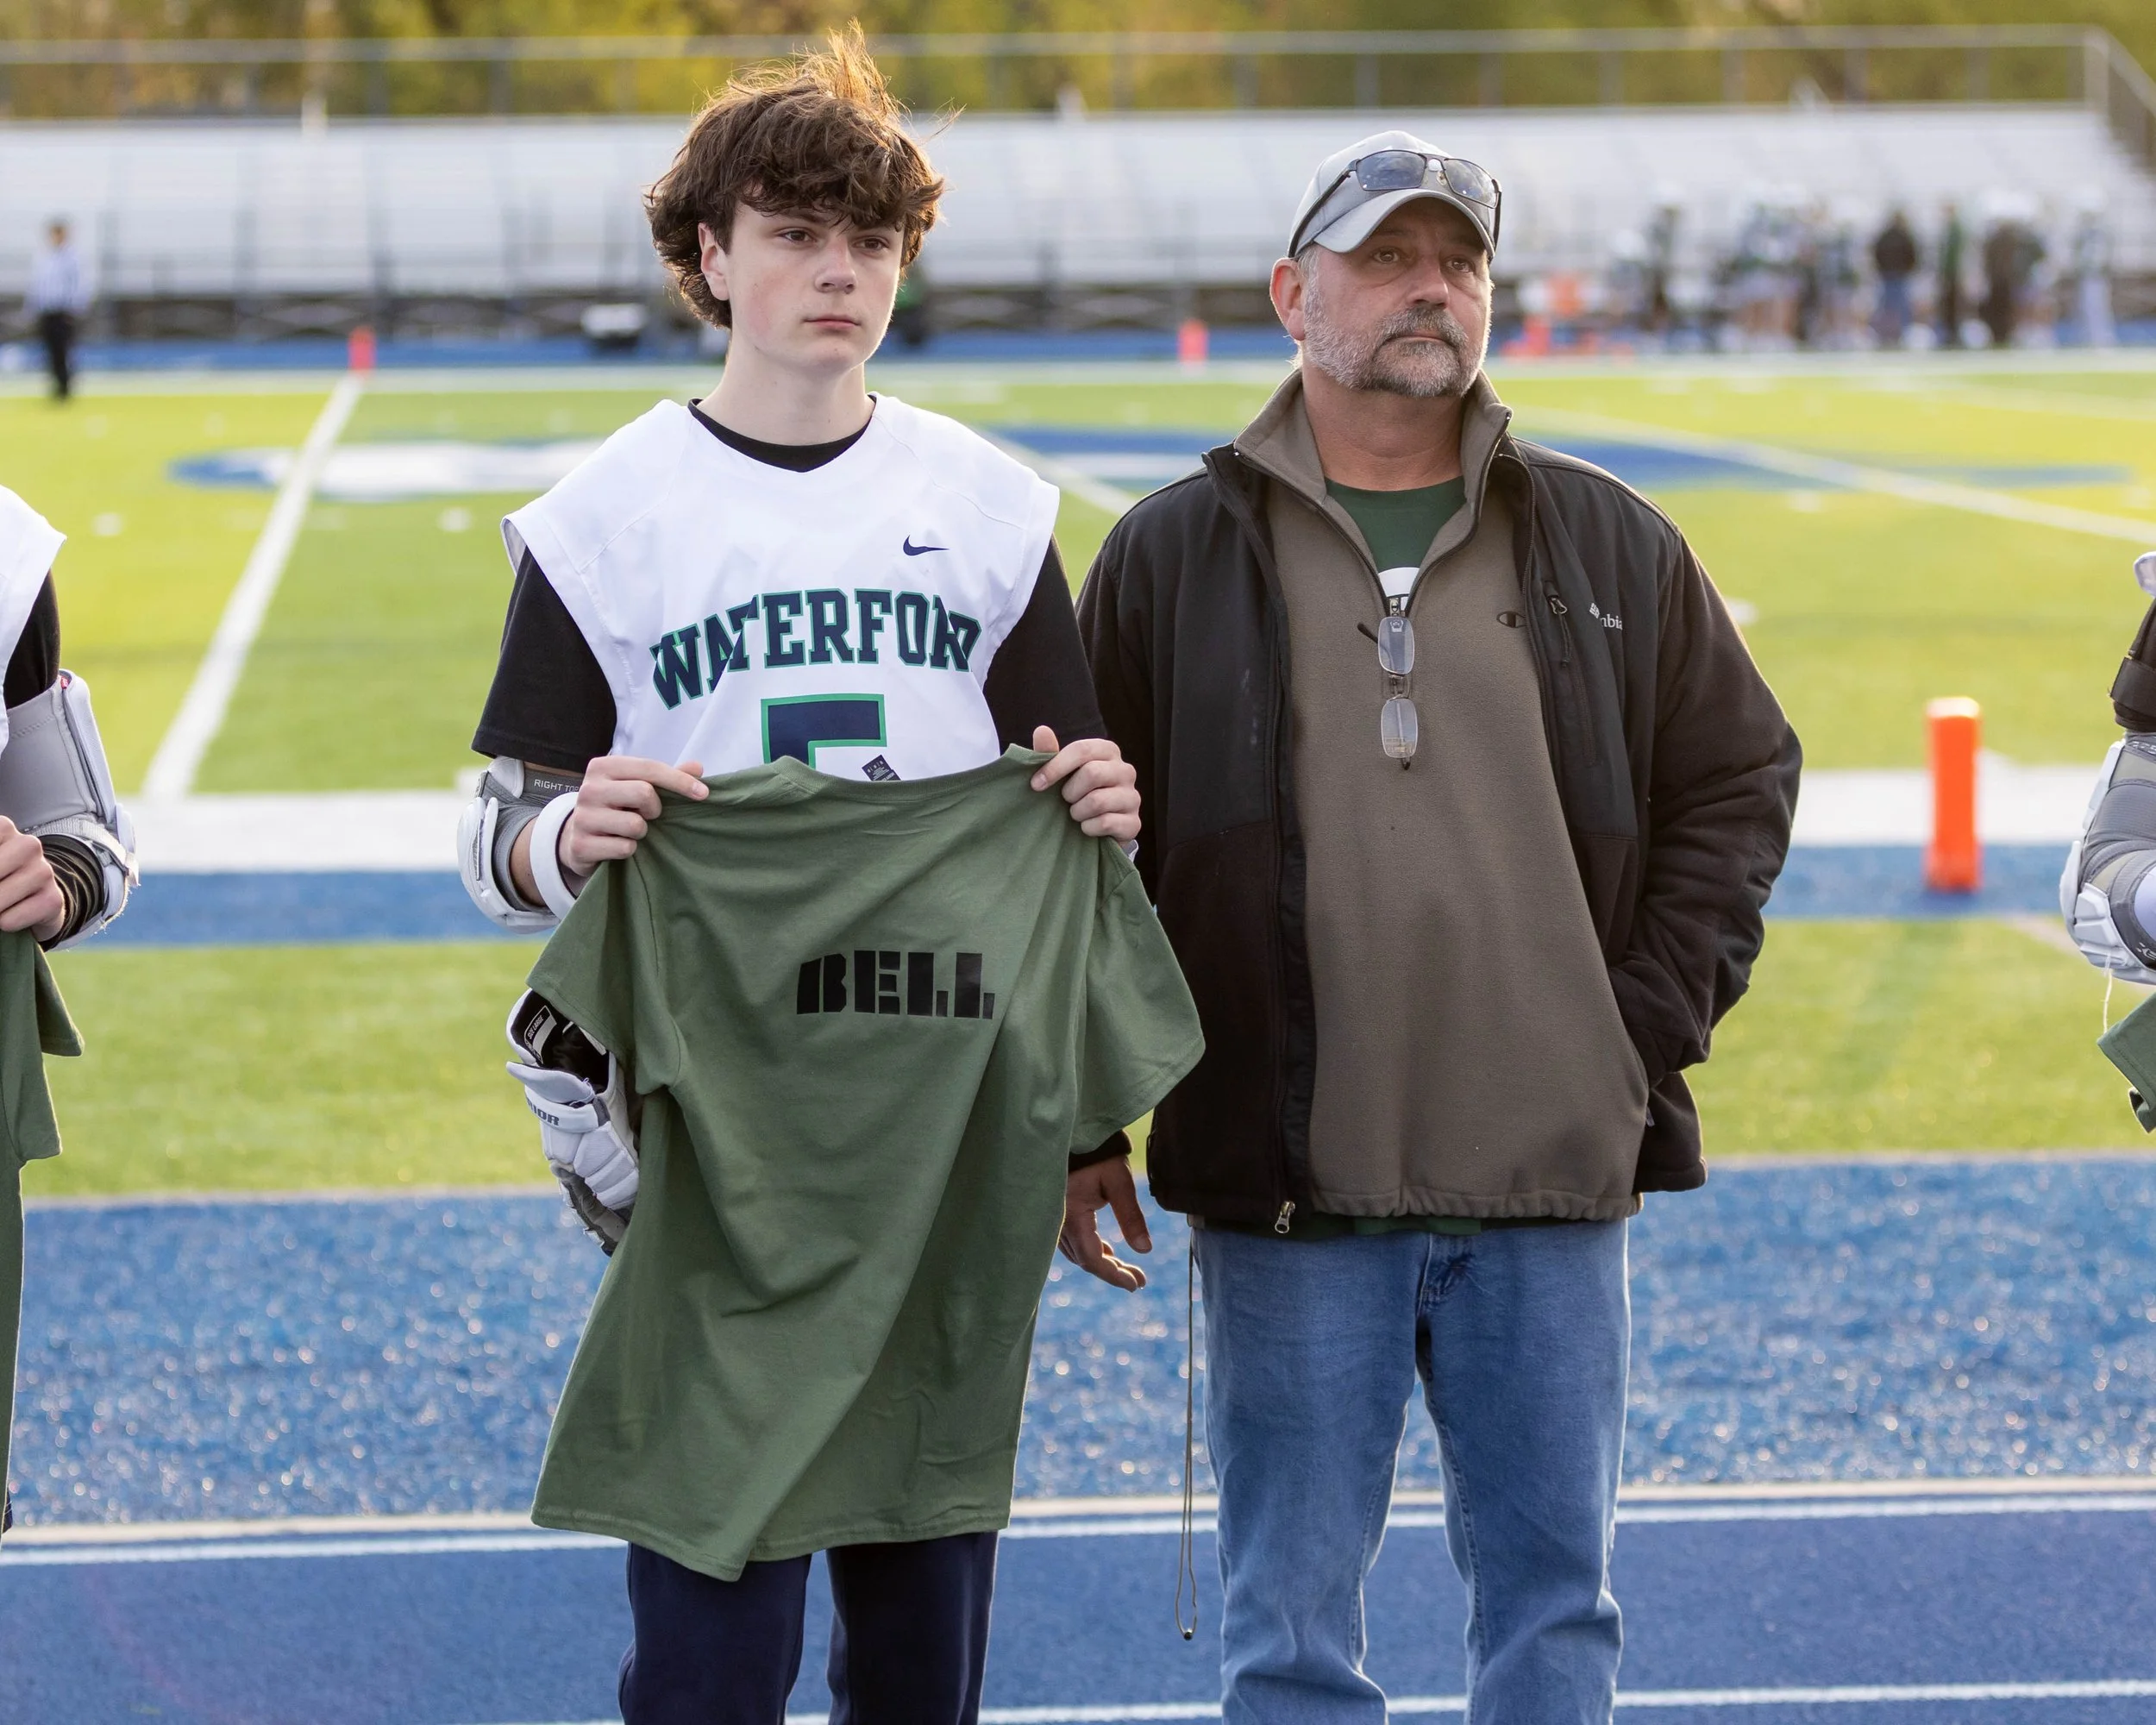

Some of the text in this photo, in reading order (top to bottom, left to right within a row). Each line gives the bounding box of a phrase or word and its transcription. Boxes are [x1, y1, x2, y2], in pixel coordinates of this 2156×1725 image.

[534, 779, 563, 791] RIGHT
[797, 950, 995, 1019] BELL
[526, 1096, 560, 1126] RIOR
